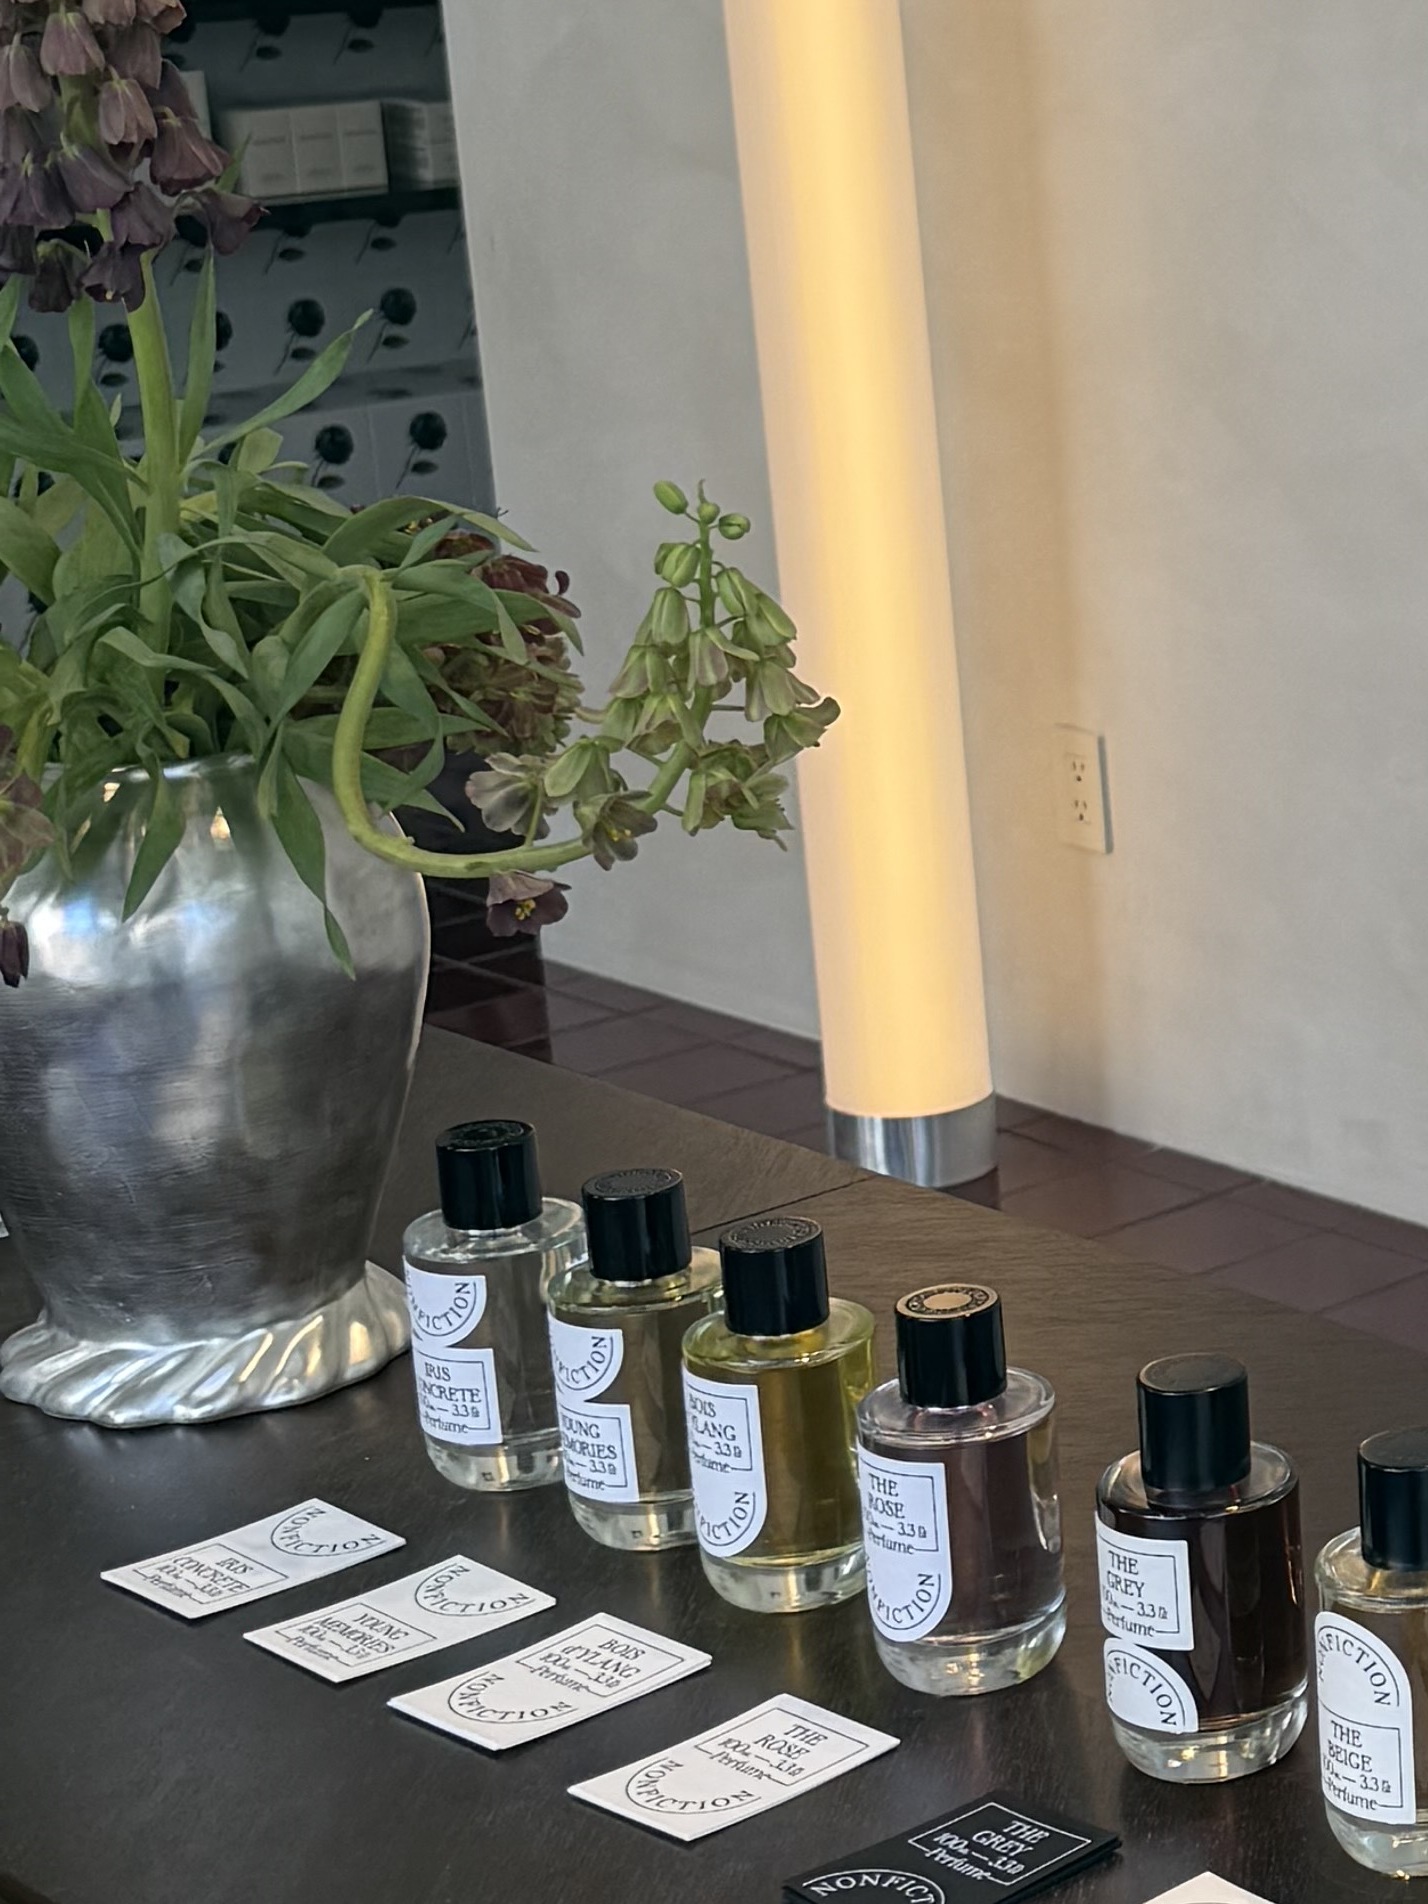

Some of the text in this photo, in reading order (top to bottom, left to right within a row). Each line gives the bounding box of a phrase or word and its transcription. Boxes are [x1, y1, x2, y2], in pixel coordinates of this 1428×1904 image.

[868, 1473, 899, 1497] THE
[279, 1506, 382, 1553] NONFICTION
[1108, 1550, 1139, 1575] THE
[423, 1564, 529, 1613] NONFICTION
[1107, 1570, 1144, 1599] GREY
[459, 1673, 571, 1721] NONFICTION
[1330, 1720, 1362, 1748] THE
[637, 1759, 754, 1810] NONFICTION
[972, 1830, 1033, 1856] GREY
[1002, 1820, 1049, 1845] THE
